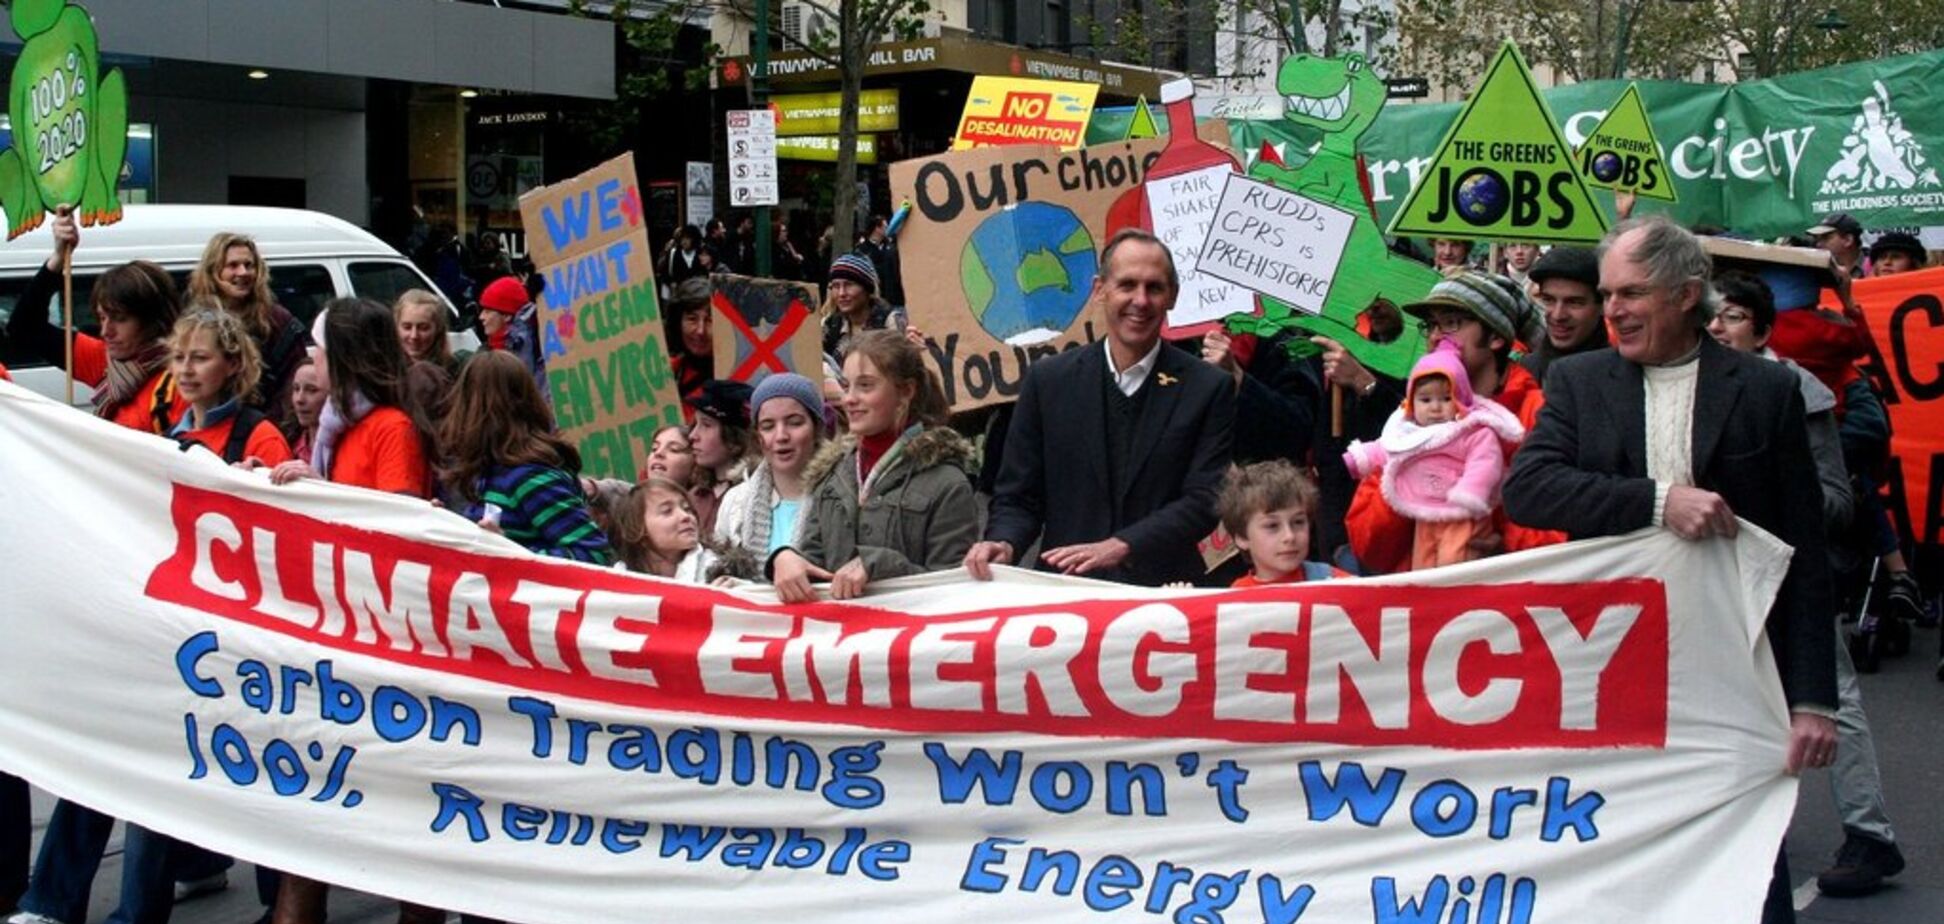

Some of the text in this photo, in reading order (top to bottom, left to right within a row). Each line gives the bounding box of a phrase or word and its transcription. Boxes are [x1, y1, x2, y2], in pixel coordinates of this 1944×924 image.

[903, 47, 935, 63] BAR
[1026, 59, 1081, 80] VIETNAMESE
[31, 51, 86, 127] 100%
[1007, 96, 1045, 120] NO
[38, 108, 86, 175] 2020
[478, 111, 546, 125] JACK LONDON
[966, 120, 1076, 143] DESALINATION
[1454, 140, 1557, 165] THE GREENS
[1564, 109, 1816, 199] Sciety
[1594, 134, 1652, 154] THE GREENS
[915, 143, 1160, 223] Our choic
[1163, 193, 1219, 221] SHAKE
[1170, 174, 1213, 197] FAIR
[1427, 166, 1575, 230] JOBS
[1811, 200, 1830, 213] THE
[1832, 195, 1899, 211] WILDERNESS
[541, 178, 622, 253] WE
[1164, 225, 1183, 243] OF
[1222, 210, 1286, 248] CPRS
[541, 240, 632, 311] WANT
[1206, 238, 1330, 297] PREHISTORIC
[543, 277, 658, 361] A CLEAN
[190, 511, 1644, 731] CLIMATE EMERGENCY
[175, 631, 1606, 844] Carbon Trading Won't Work
[184, 712, 1537, 924] 100% Renewable Energy Will
